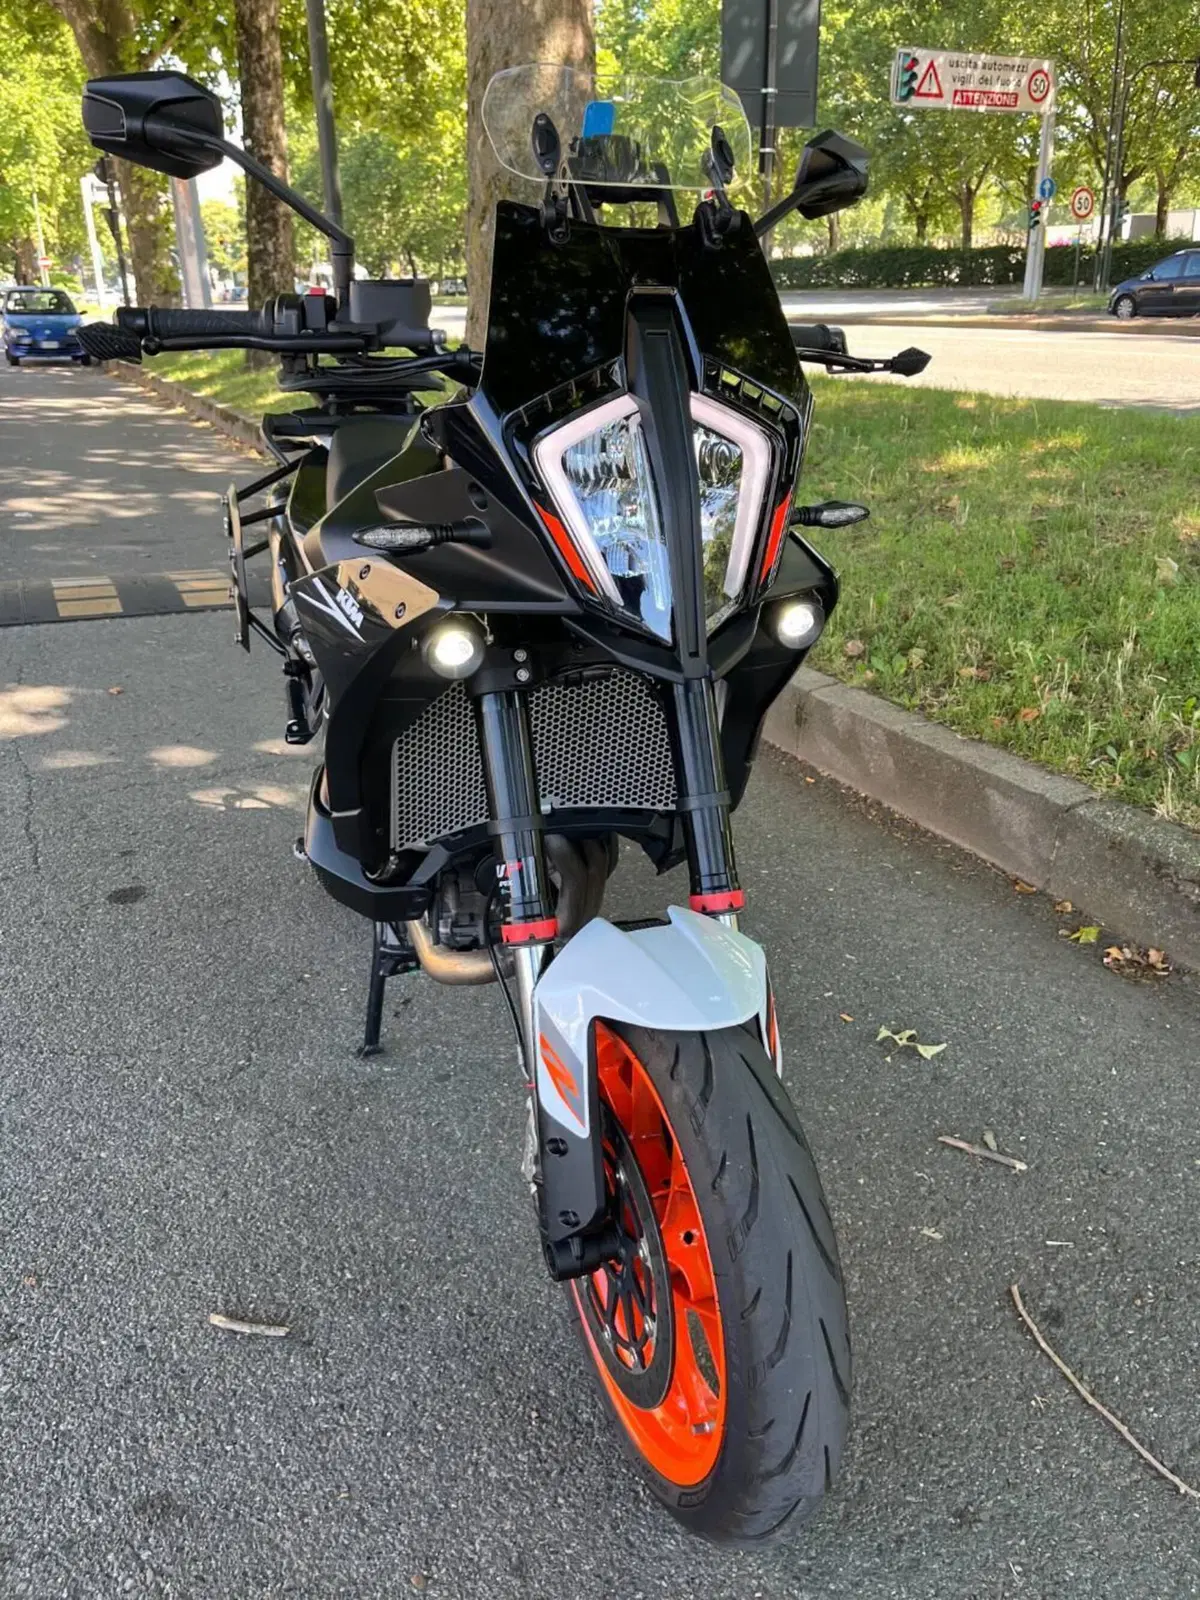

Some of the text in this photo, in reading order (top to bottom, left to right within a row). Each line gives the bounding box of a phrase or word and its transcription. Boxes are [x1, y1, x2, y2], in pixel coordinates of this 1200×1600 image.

[949, 59, 1029, 73] uscita automezzi
[1032, 78, 1046, 94] 50
[954, 91, 1016, 106] ATTENZIONE
[1077, 196, 1089, 211] 50
[336, 588, 364, 629] KTM
